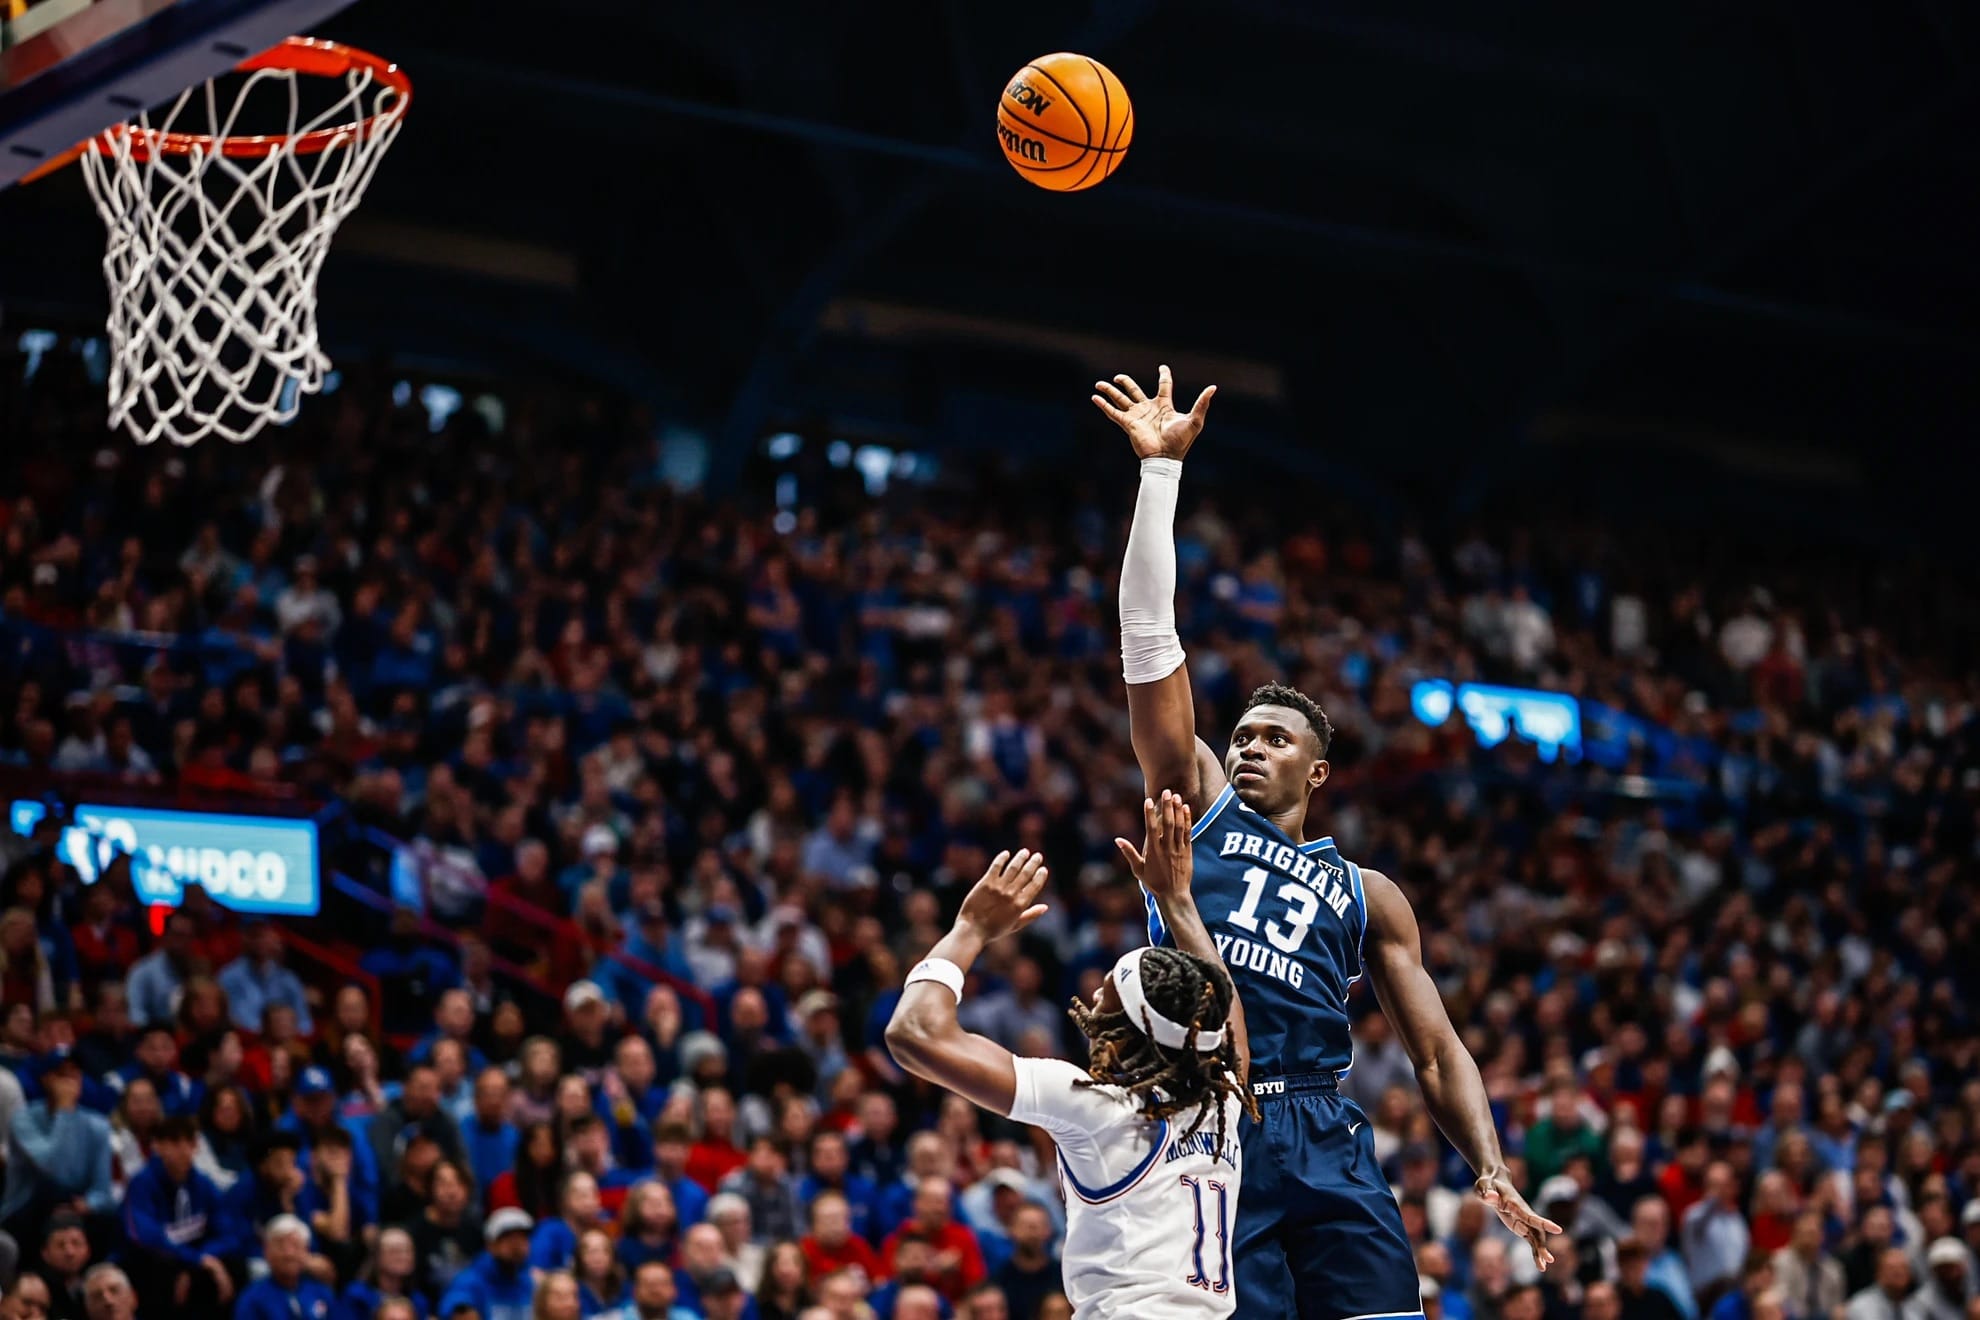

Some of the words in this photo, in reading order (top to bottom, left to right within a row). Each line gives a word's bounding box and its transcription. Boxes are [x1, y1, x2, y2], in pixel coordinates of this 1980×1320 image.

[1219, 831, 1352, 920] BRIGHAM
[1226, 865, 1320, 954] 13
[1213, 933, 1304, 990] YOUNG
[1253, 1080, 1285, 1096] BYU
[1180, 1174, 1229, 1295] 11
